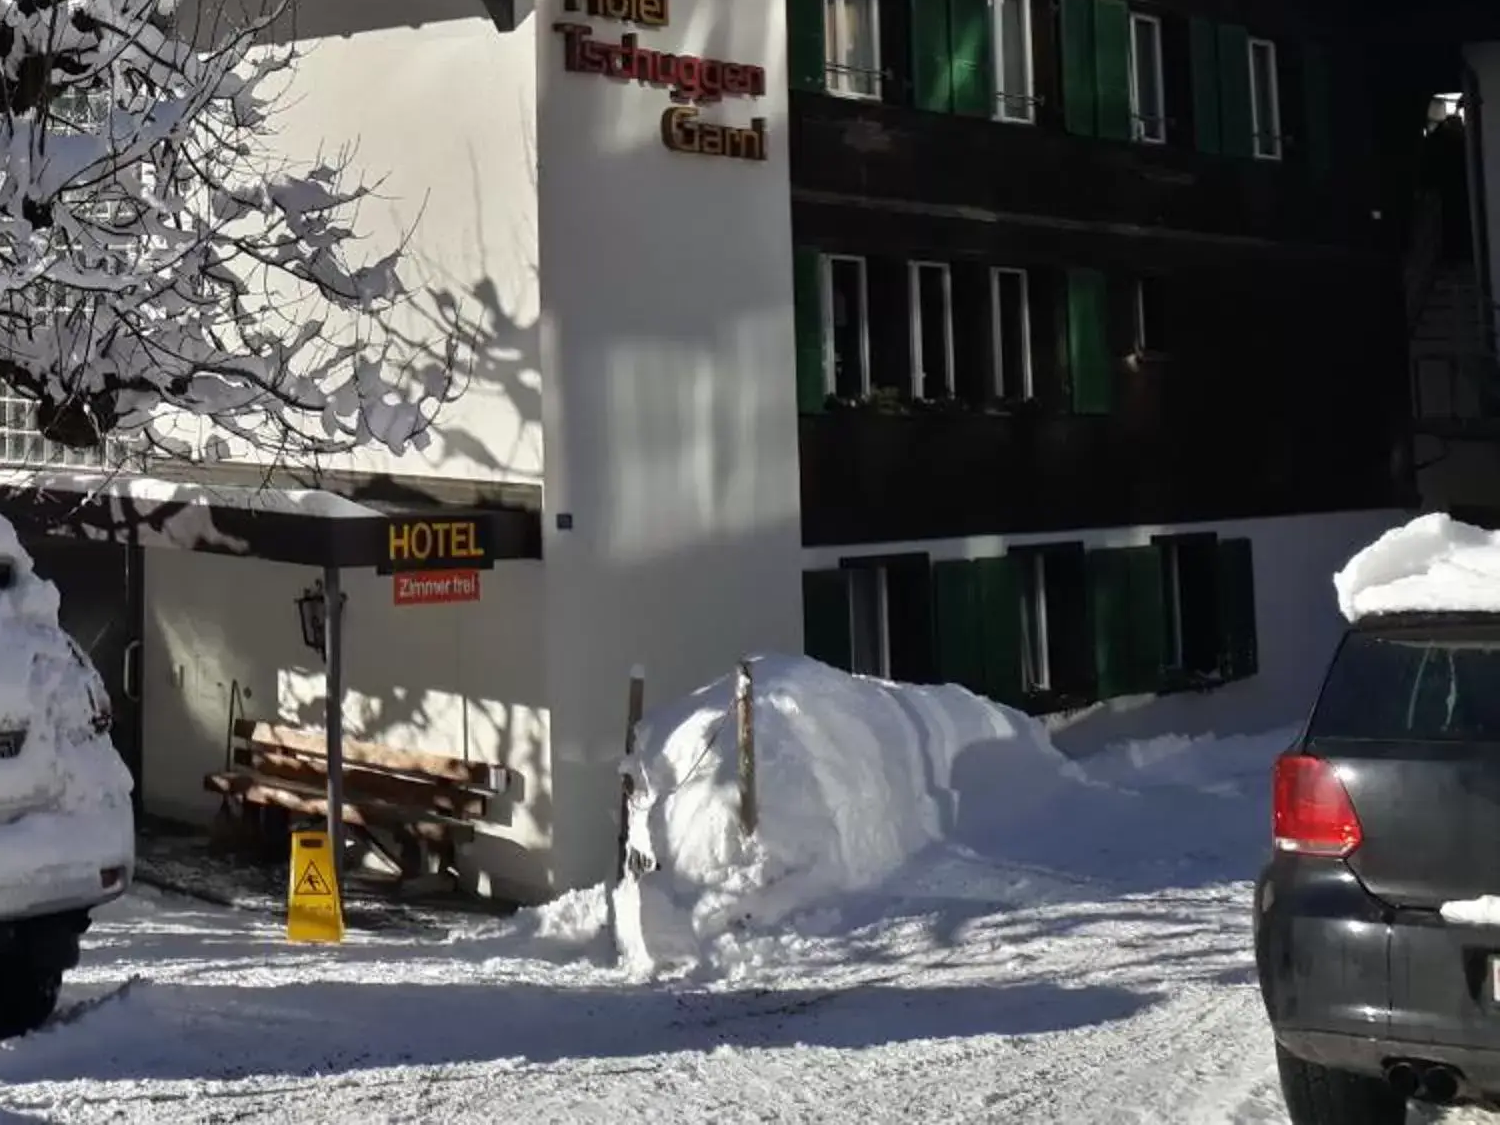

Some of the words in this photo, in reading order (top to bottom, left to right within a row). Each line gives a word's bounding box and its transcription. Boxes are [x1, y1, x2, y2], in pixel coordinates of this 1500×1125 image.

[552, 23, 766, 105] Tschuggen
[661, 106, 767, 160] Garni
[389, 522, 485, 560] HOTEL
